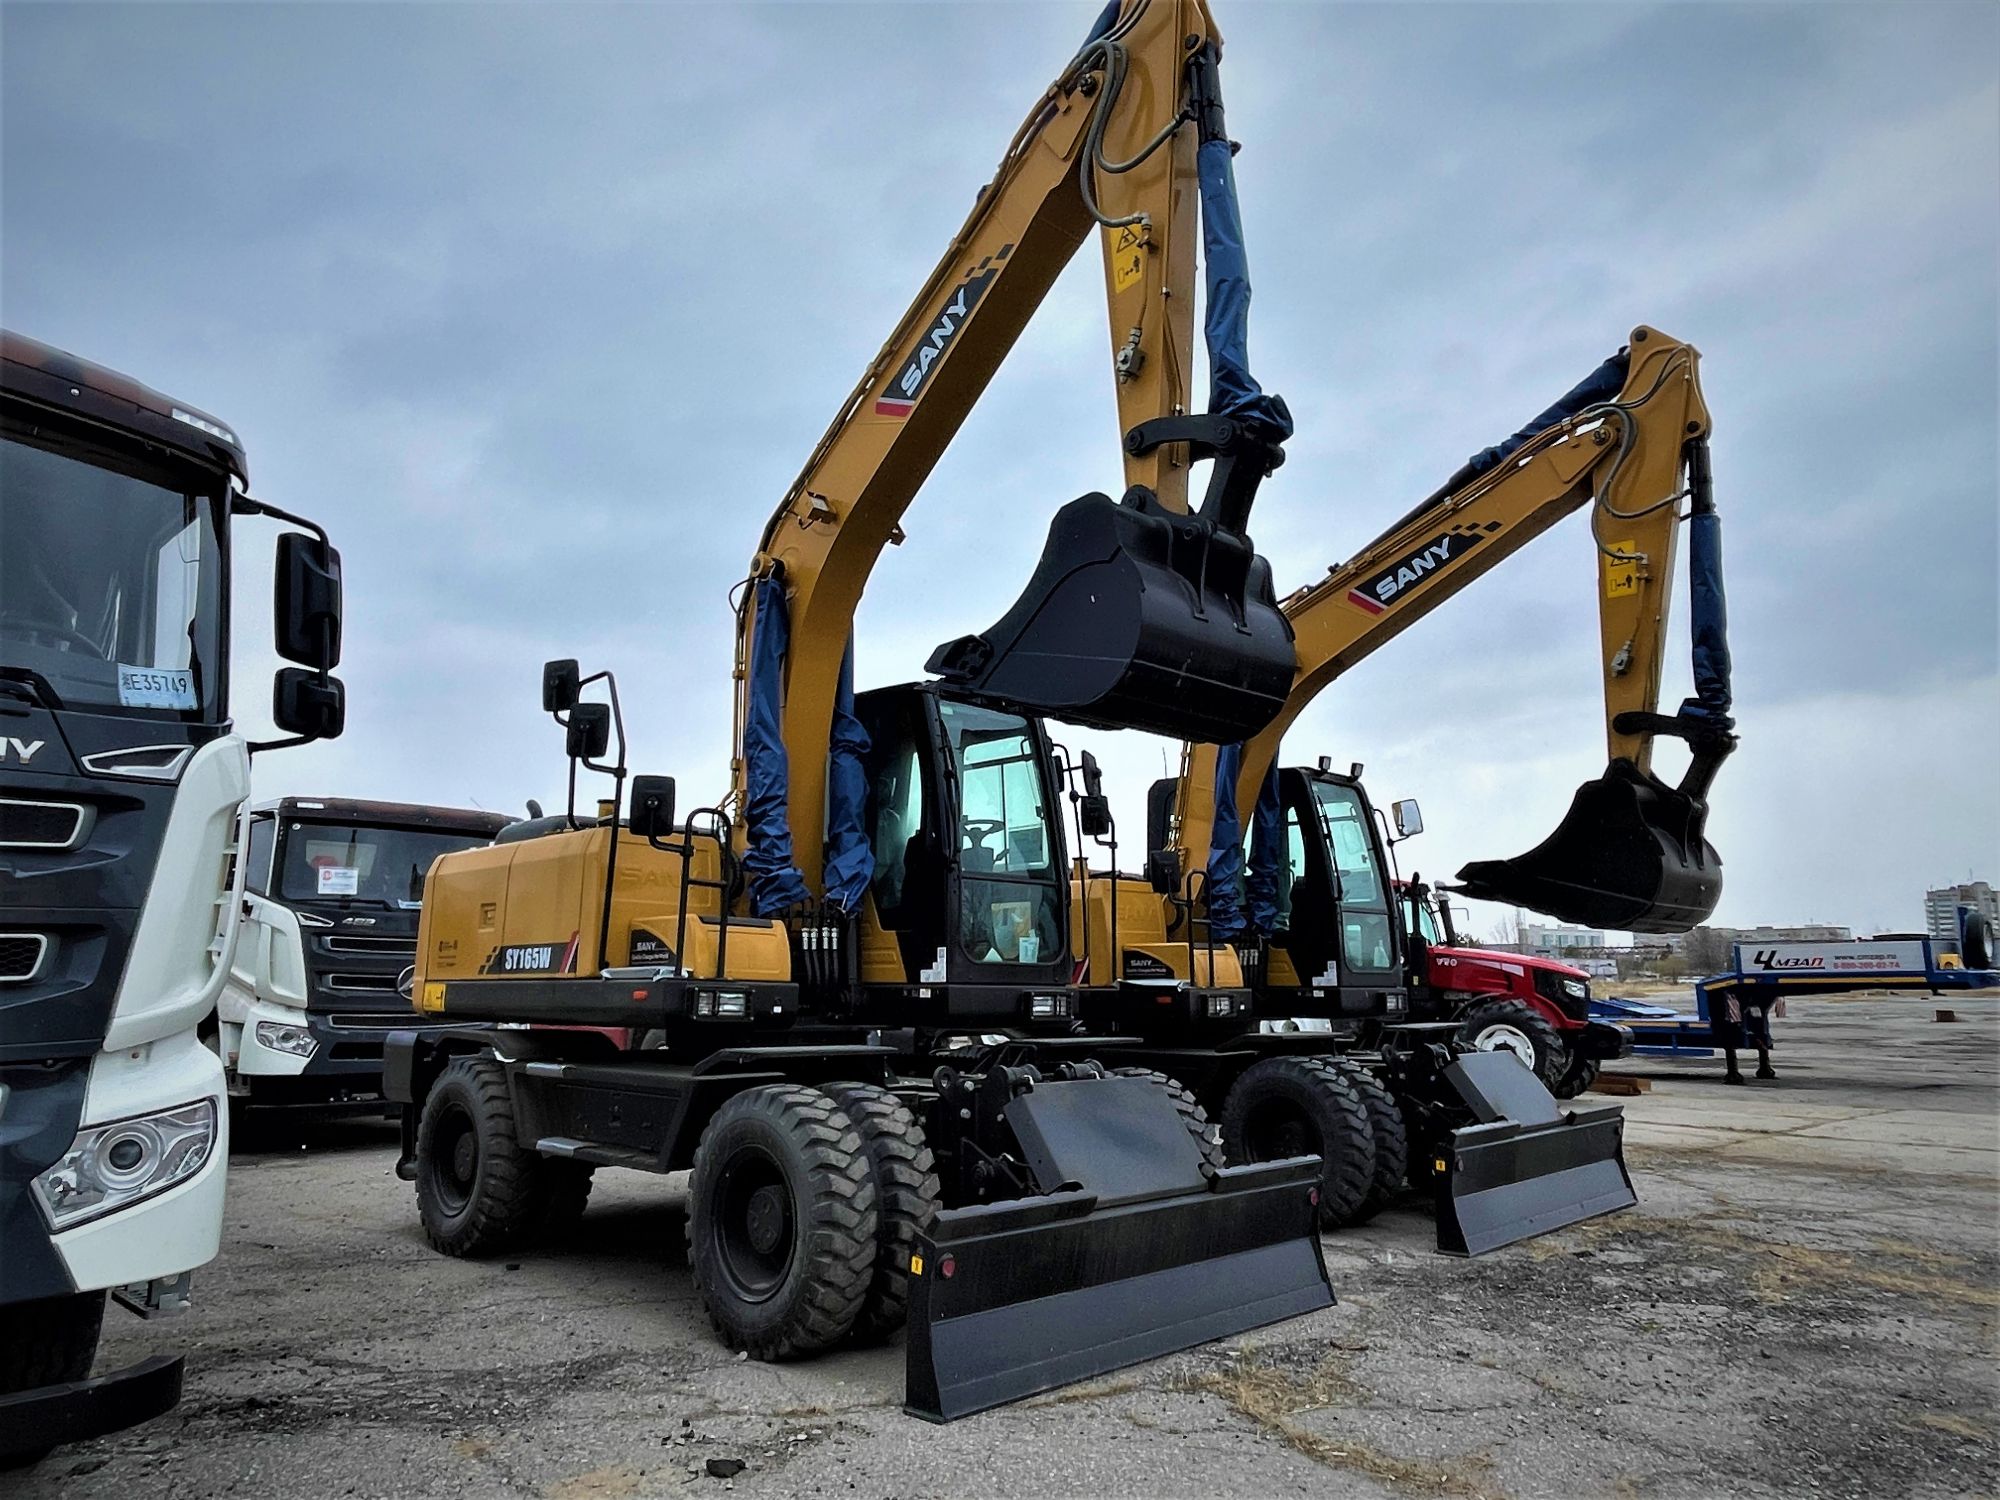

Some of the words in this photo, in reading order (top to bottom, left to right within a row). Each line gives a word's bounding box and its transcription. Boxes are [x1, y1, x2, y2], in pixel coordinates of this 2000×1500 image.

[901, 287, 968, 398] SANY
[1376, 535, 1450, 601] SANY
[0, 736, 46, 764] Y
[504, 946, 552, 970] SY165W
